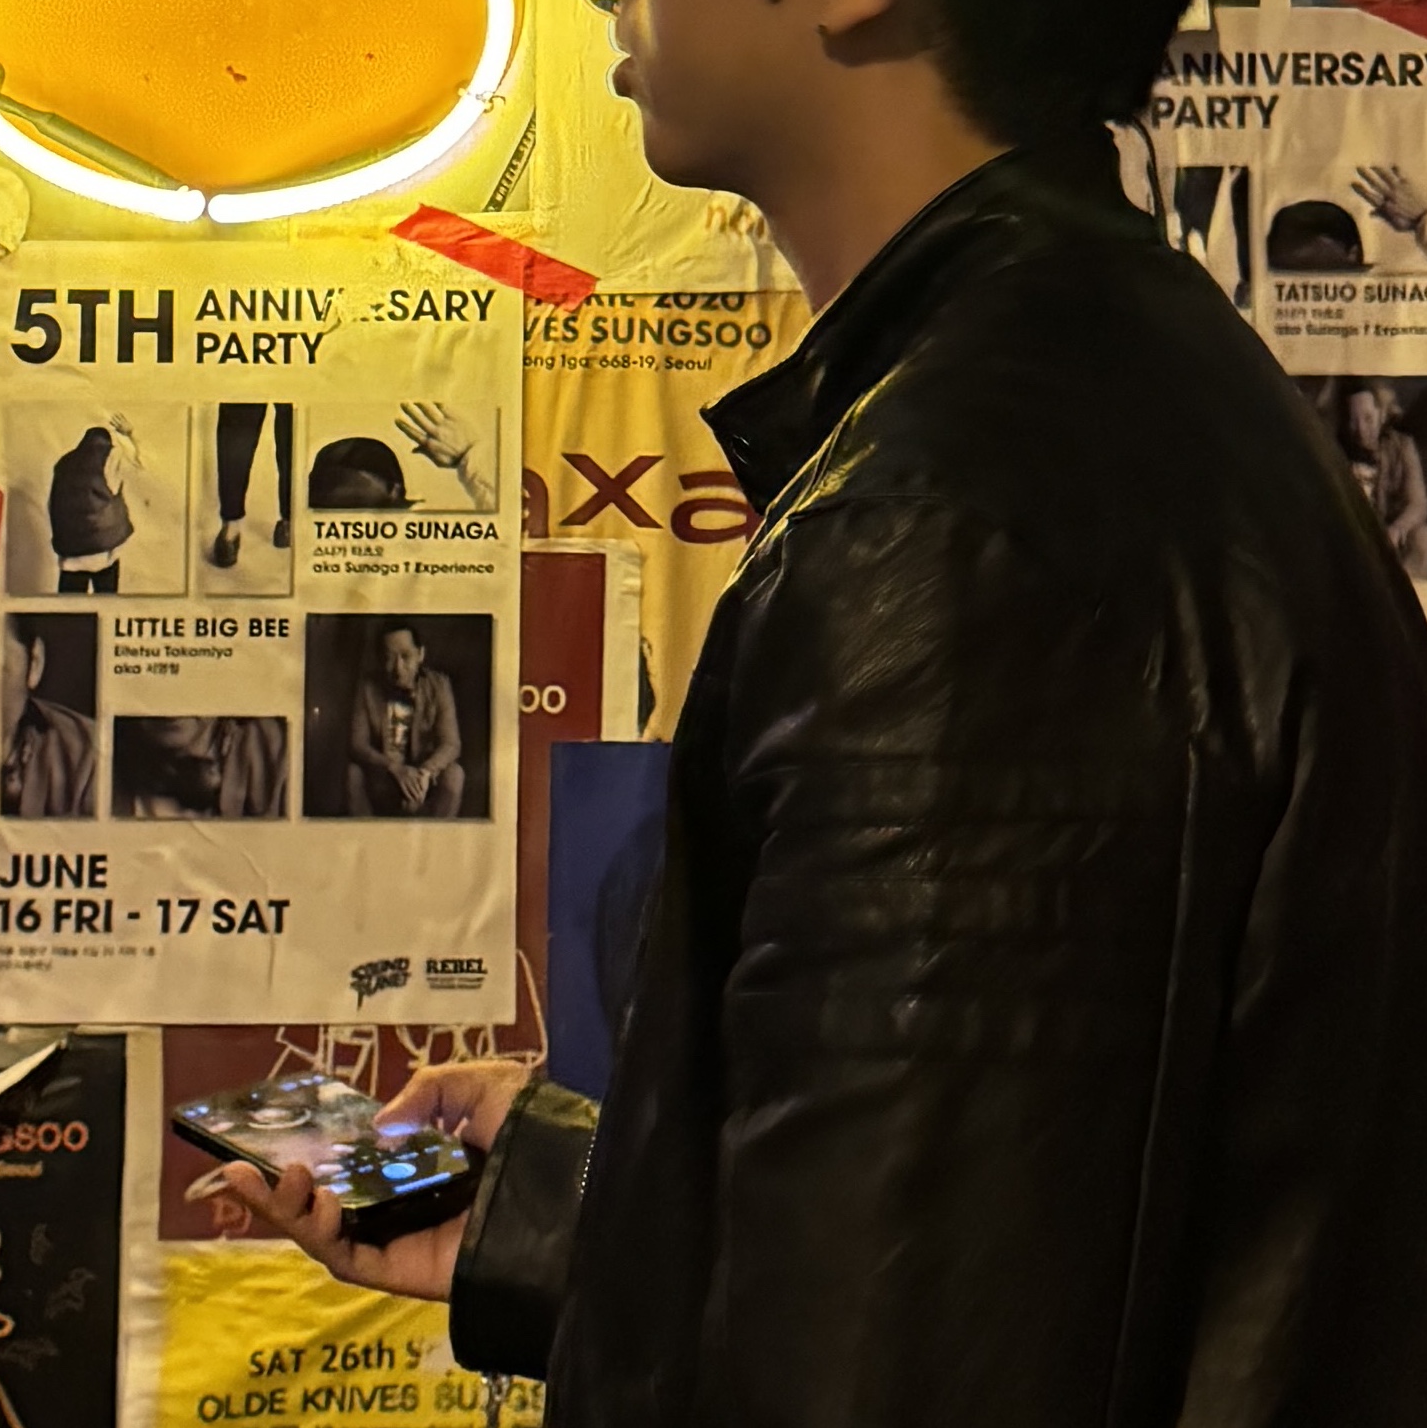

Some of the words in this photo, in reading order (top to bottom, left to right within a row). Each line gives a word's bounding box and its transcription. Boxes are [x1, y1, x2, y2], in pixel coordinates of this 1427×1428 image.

[1150, 95, 1280, 130] PARTY
[1274, 282, 1357, 304] TATSUO
[10, 288, 173, 365] 5TH
[195, 287, 497, 323] ANNIVSARY
[590, 315, 772, 350] SUNGSOO
[195, 331, 325, 365] PARTY
[664, 356, 713, 372] Seoul
[313, 521, 398, 541] TATSUO
[404, 521, 499, 541] SUNAGA
[114, 617, 186, 638] LITTLE
[195, 617, 239, 638] BIG
[248, 617, 290, 638] BEE
[52, 898, 114, 934] FRI
[157, 898, 200, 934] 17
[211, 897, 290, 935] SAT
[248, 1347, 306, 1379] SAT
[321, 1337, 396, 1374] 26th
[198, 1387, 287, 1423] OLDE
[301, 1382, 420, 1413] KNIVES
